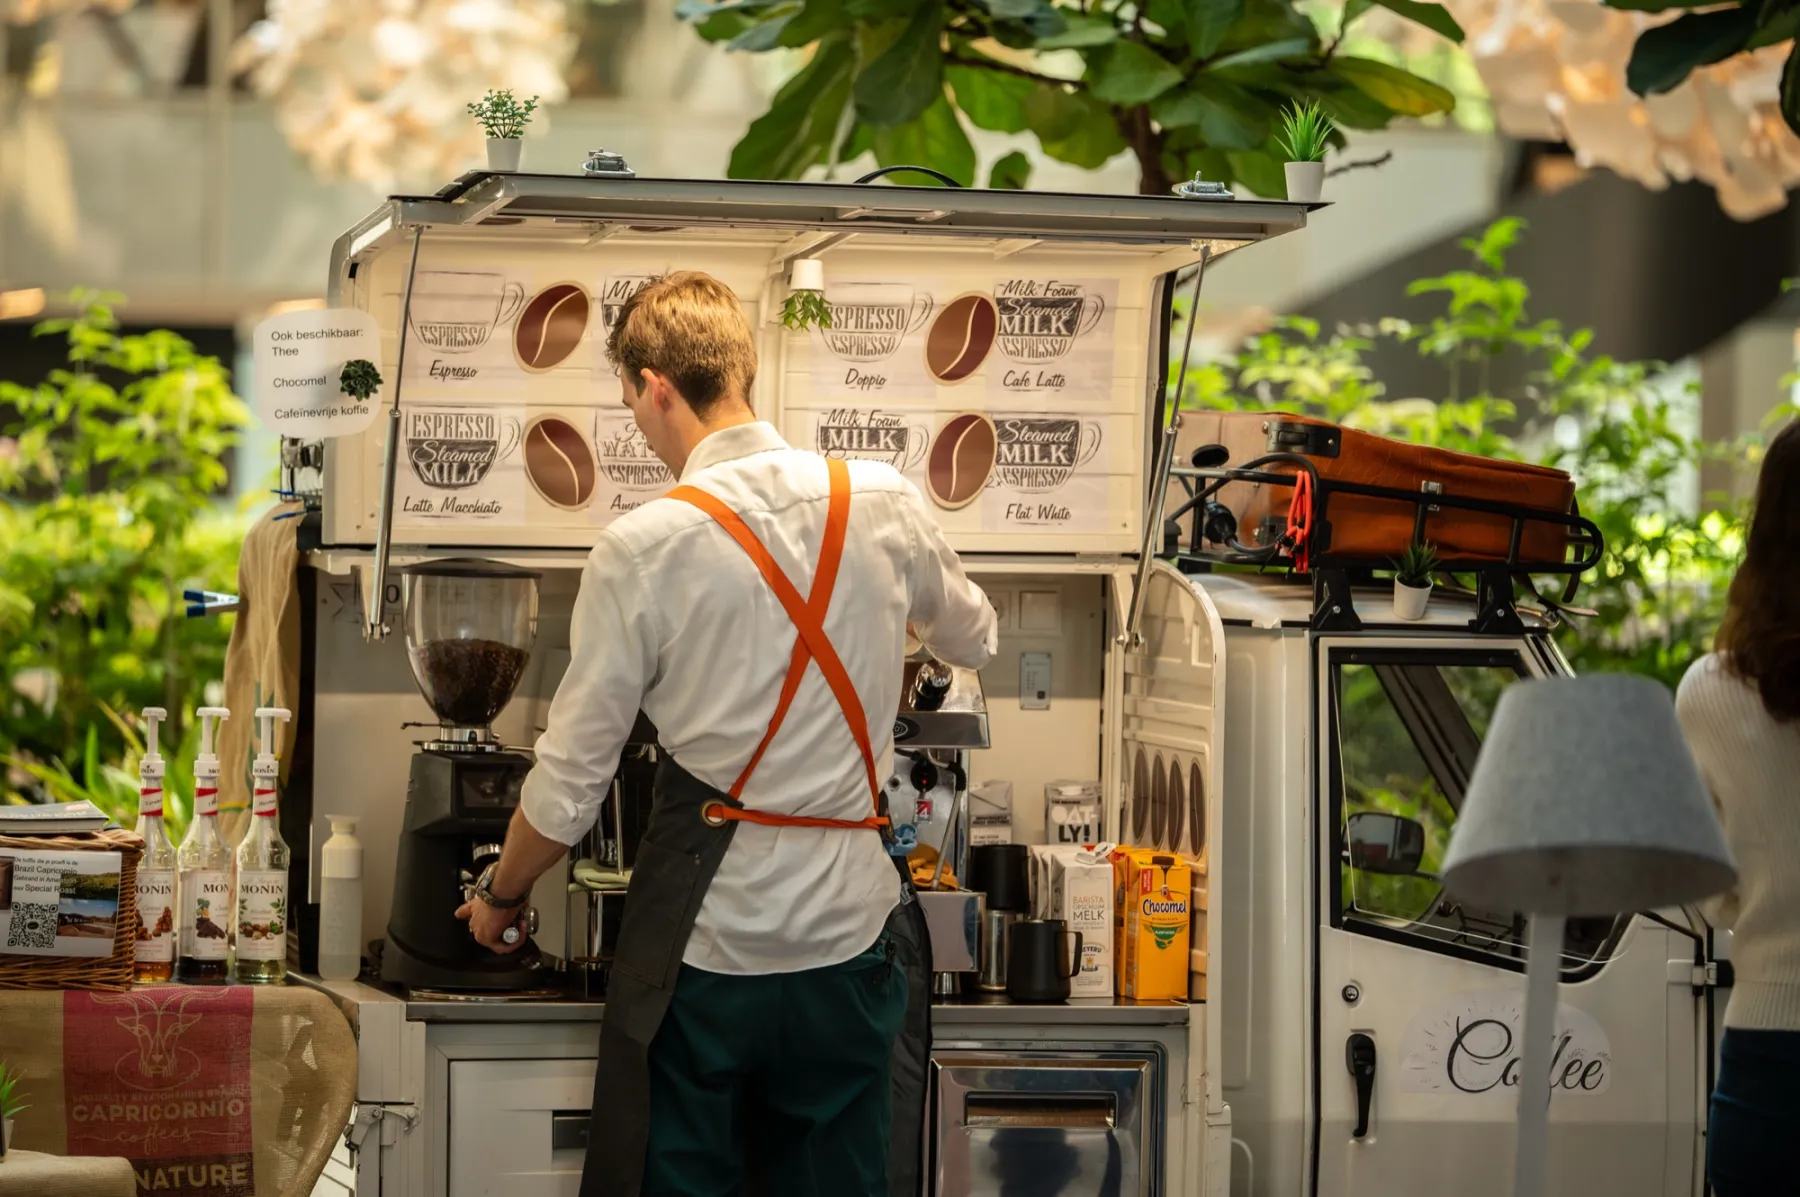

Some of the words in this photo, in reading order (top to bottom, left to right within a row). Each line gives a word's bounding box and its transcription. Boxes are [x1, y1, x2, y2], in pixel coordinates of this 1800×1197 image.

[1003, 279, 1036, 296] Milk
[1043, 280, 1077, 296] Foam
[999, 297, 1077, 316] Steamed
[271, 331, 293, 341] Ook
[296, 328, 363, 340] beschikbaar:
[999, 315, 1072, 335] MILK
[419, 325, 487, 347] ESPRESSO
[831, 335, 896, 356] ESPRESSO
[272, 346, 299, 357] Thee
[1002, 337, 1068, 358] ESPRESSO
[429, 360, 479, 382] Espresso
[845, 368, 887, 391] Doppio
[1036, 371, 1066, 387] Latte
[273, 376, 327, 388] Chocomel
[274, 407, 338, 420] Cafeïnevrije
[341, 405, 369, 416] koffie
[827, 408, 861, 427] Milk
[867, 409, 902, 428] Foam
[413, 414, 494, 439] ESPRESSO
[997, 420, 1075, 443] Steamed
[828, 428, 900, 449] MILK
[412, 440, 495, 463] Steamed
[999, 444, 1071, 465] MILK
[418, 462, 487, 484] MILK
[1002, 467, 1067, 487] ESPRESSO
[403, 495, 434, 513] Latte
[440, 496, 503, 514] Macchiato
[1006, 503, 1034, 520] Flat
[1038, 503, 1071, 520] White
[1059, 825, 1090, 842] LY!
[15, 864, 35, 873] Brazil
[36, 866, 77, 876] Capricornio
[25, 884, 52, 893] Special
[54, 885, 76, 895] Roast
[241, 884, 284, 894] MONIN
[1073, 910, 1105, 920] MELK
[1142, 899, 1187, 916] Chocomel
[72, 1099, 244, 1122] CAPRICORNIO
